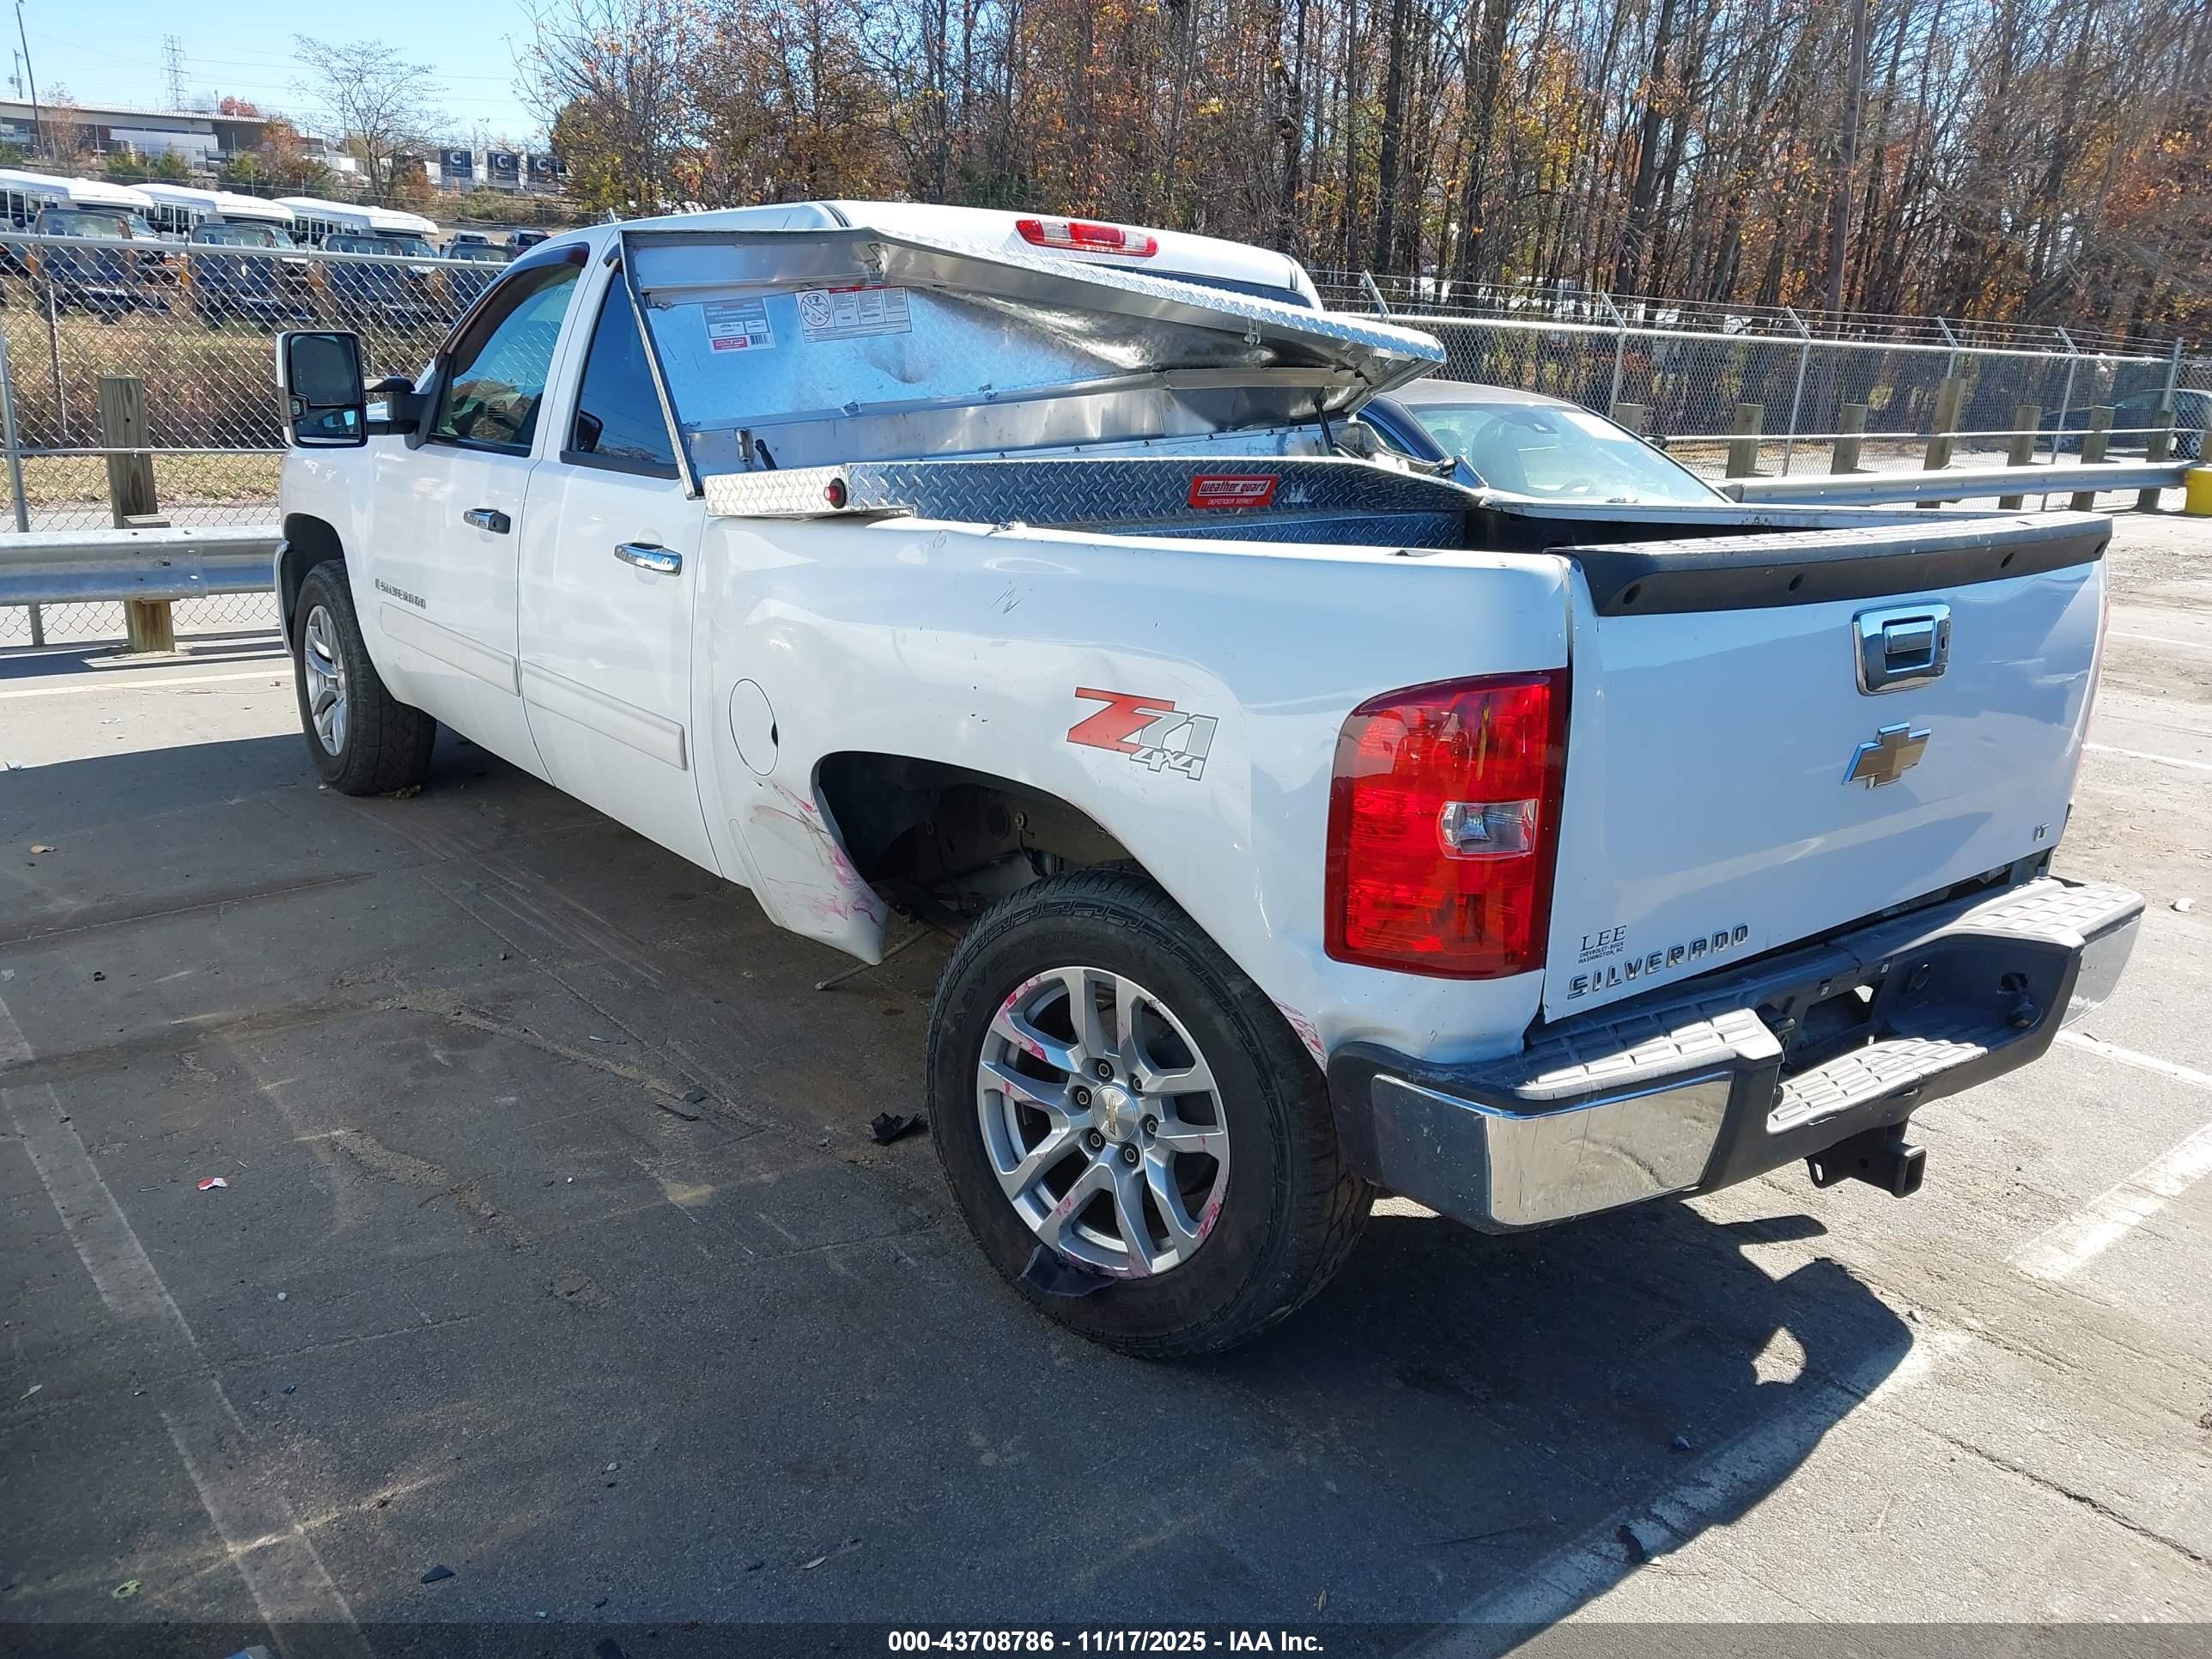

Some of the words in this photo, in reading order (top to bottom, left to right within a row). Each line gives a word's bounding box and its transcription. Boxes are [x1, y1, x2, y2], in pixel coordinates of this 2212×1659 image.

[1200, 480, 1239, 493] weather
[1241, 480, 1270, 494] guard
[1066, 686, 1219, 760] Z71
[1567, 923, 1749, 1000] SILVERADO
[1580, 925, 1627, 952] LEE
